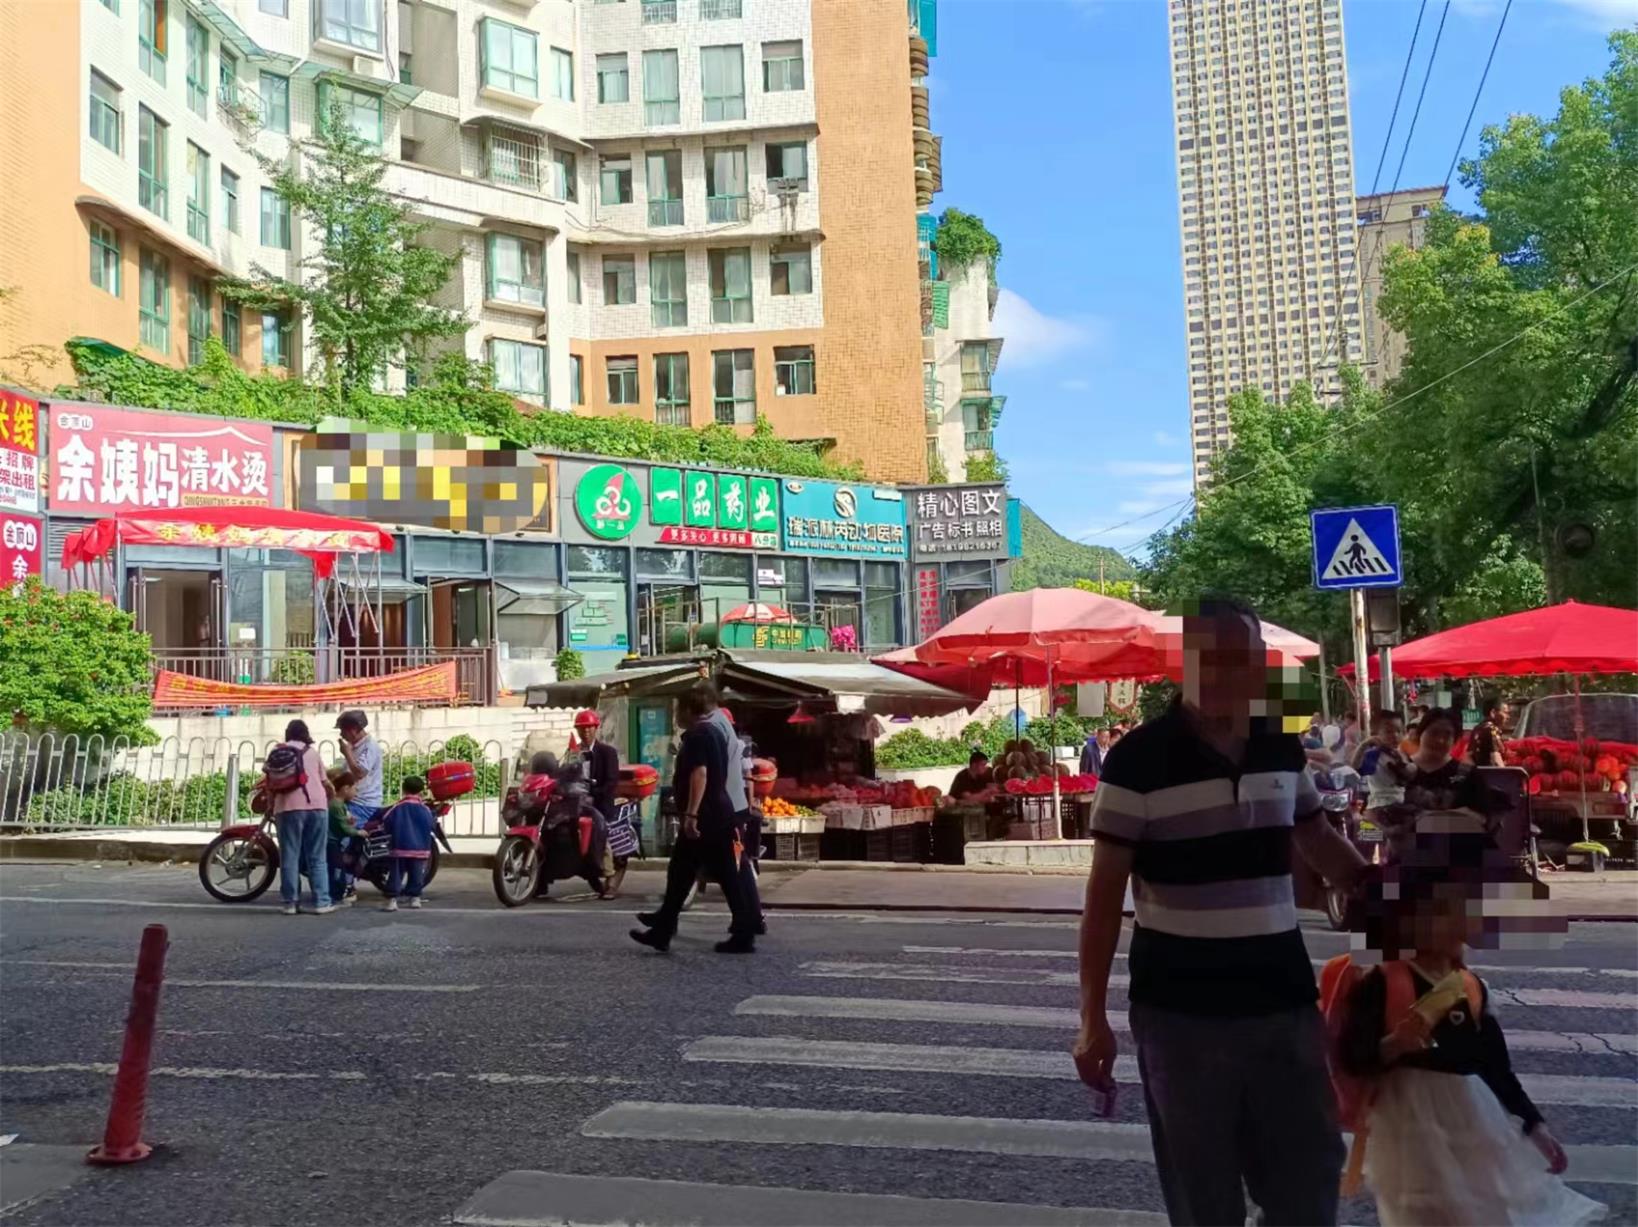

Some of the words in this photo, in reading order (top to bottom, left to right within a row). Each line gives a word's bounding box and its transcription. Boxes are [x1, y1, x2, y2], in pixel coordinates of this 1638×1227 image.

[0, 451, 34, 471] 招牌
[57, 434, 269, 507] 余姨妈清水烫
[655, 478, 776, 523] 一品药业
[917, 489, 1002, 518] 精心图文
[919, 520, 1003, 539] 广告标书照相
